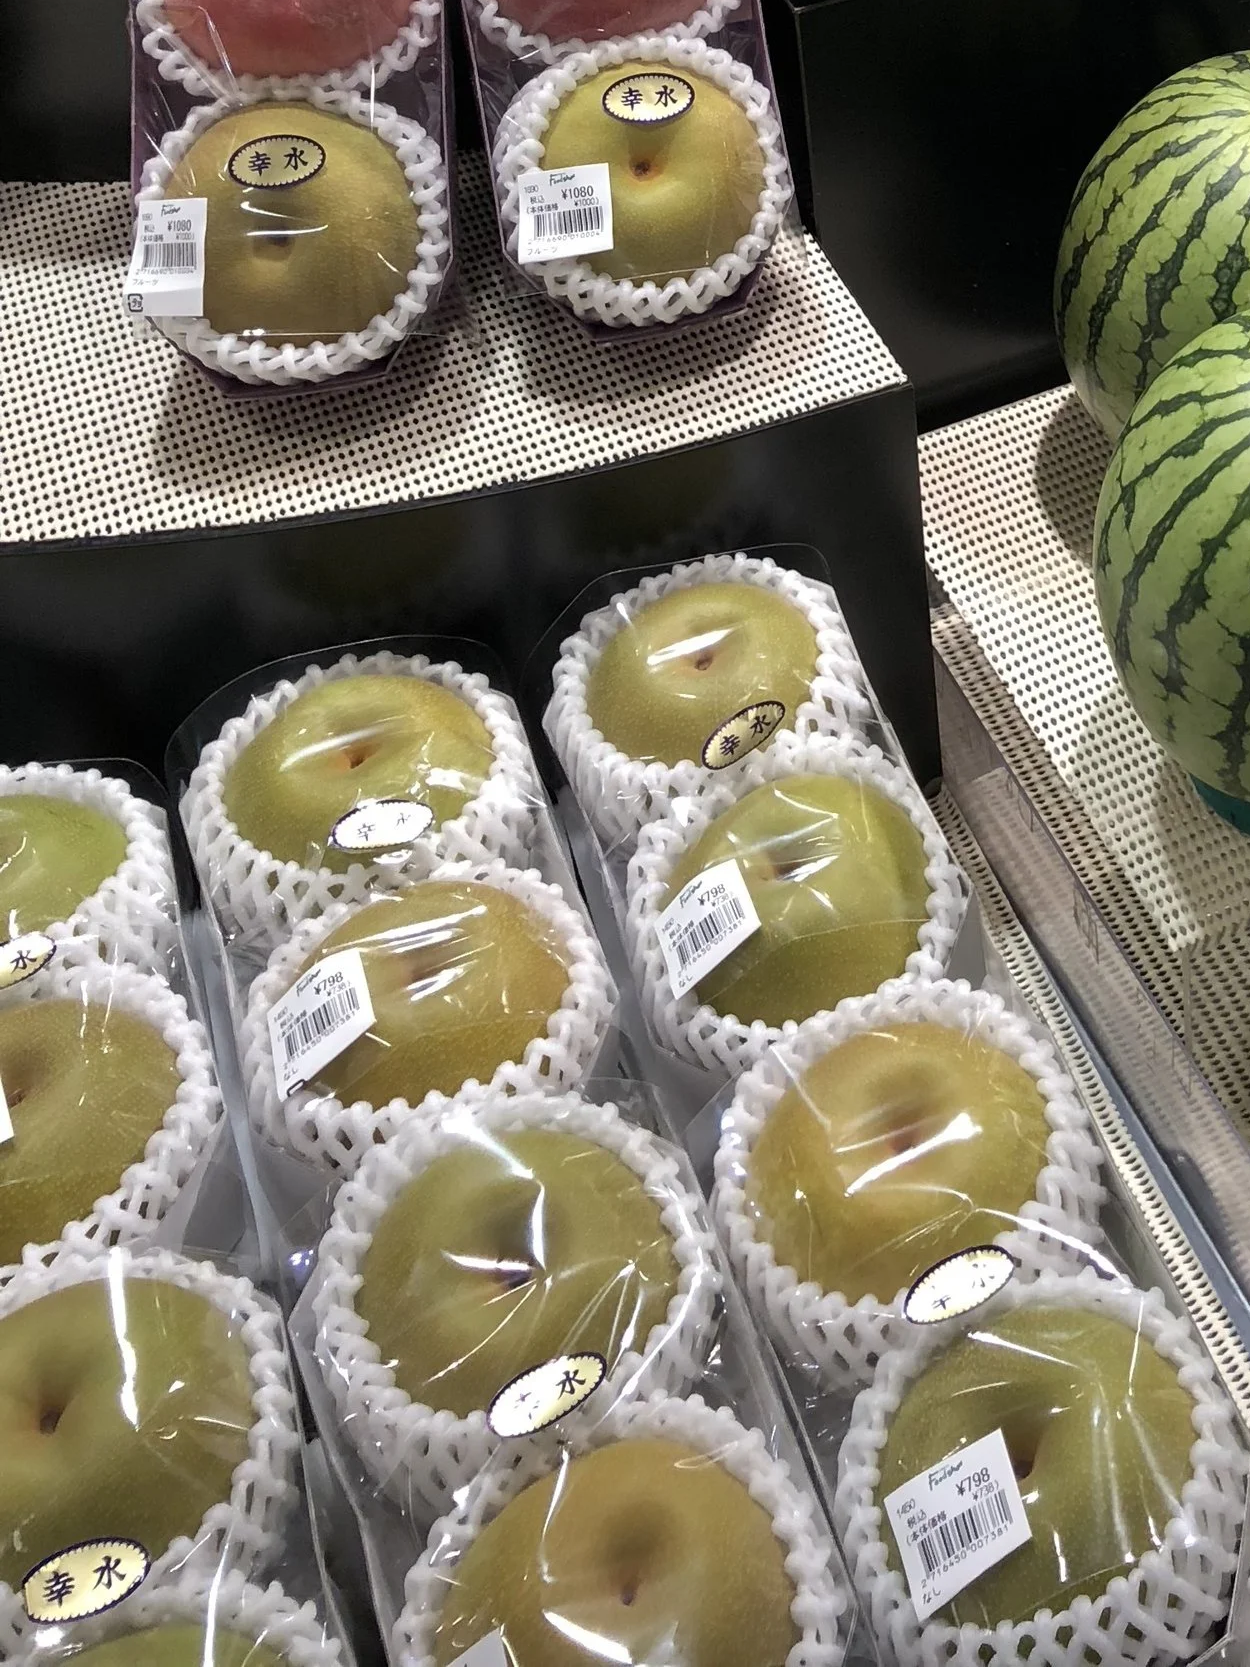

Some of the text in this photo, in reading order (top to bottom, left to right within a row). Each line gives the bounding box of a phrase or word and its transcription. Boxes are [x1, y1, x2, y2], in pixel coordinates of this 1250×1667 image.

[620, 85, 678, 112] 幸水
[248, 146, 309, 176] 幸水
[561, 185, 594, 200] ¥1080
[168, 219, 192, 232] ¥1080
[720, 713, 771, 757] 幸水
[698, 884, 726, 907] ¥798
[314, 971, 344, 995] ¥798
[956, 1467, 990, 1497] ¥798
[43, 1555, 126, 1608] 幸水
